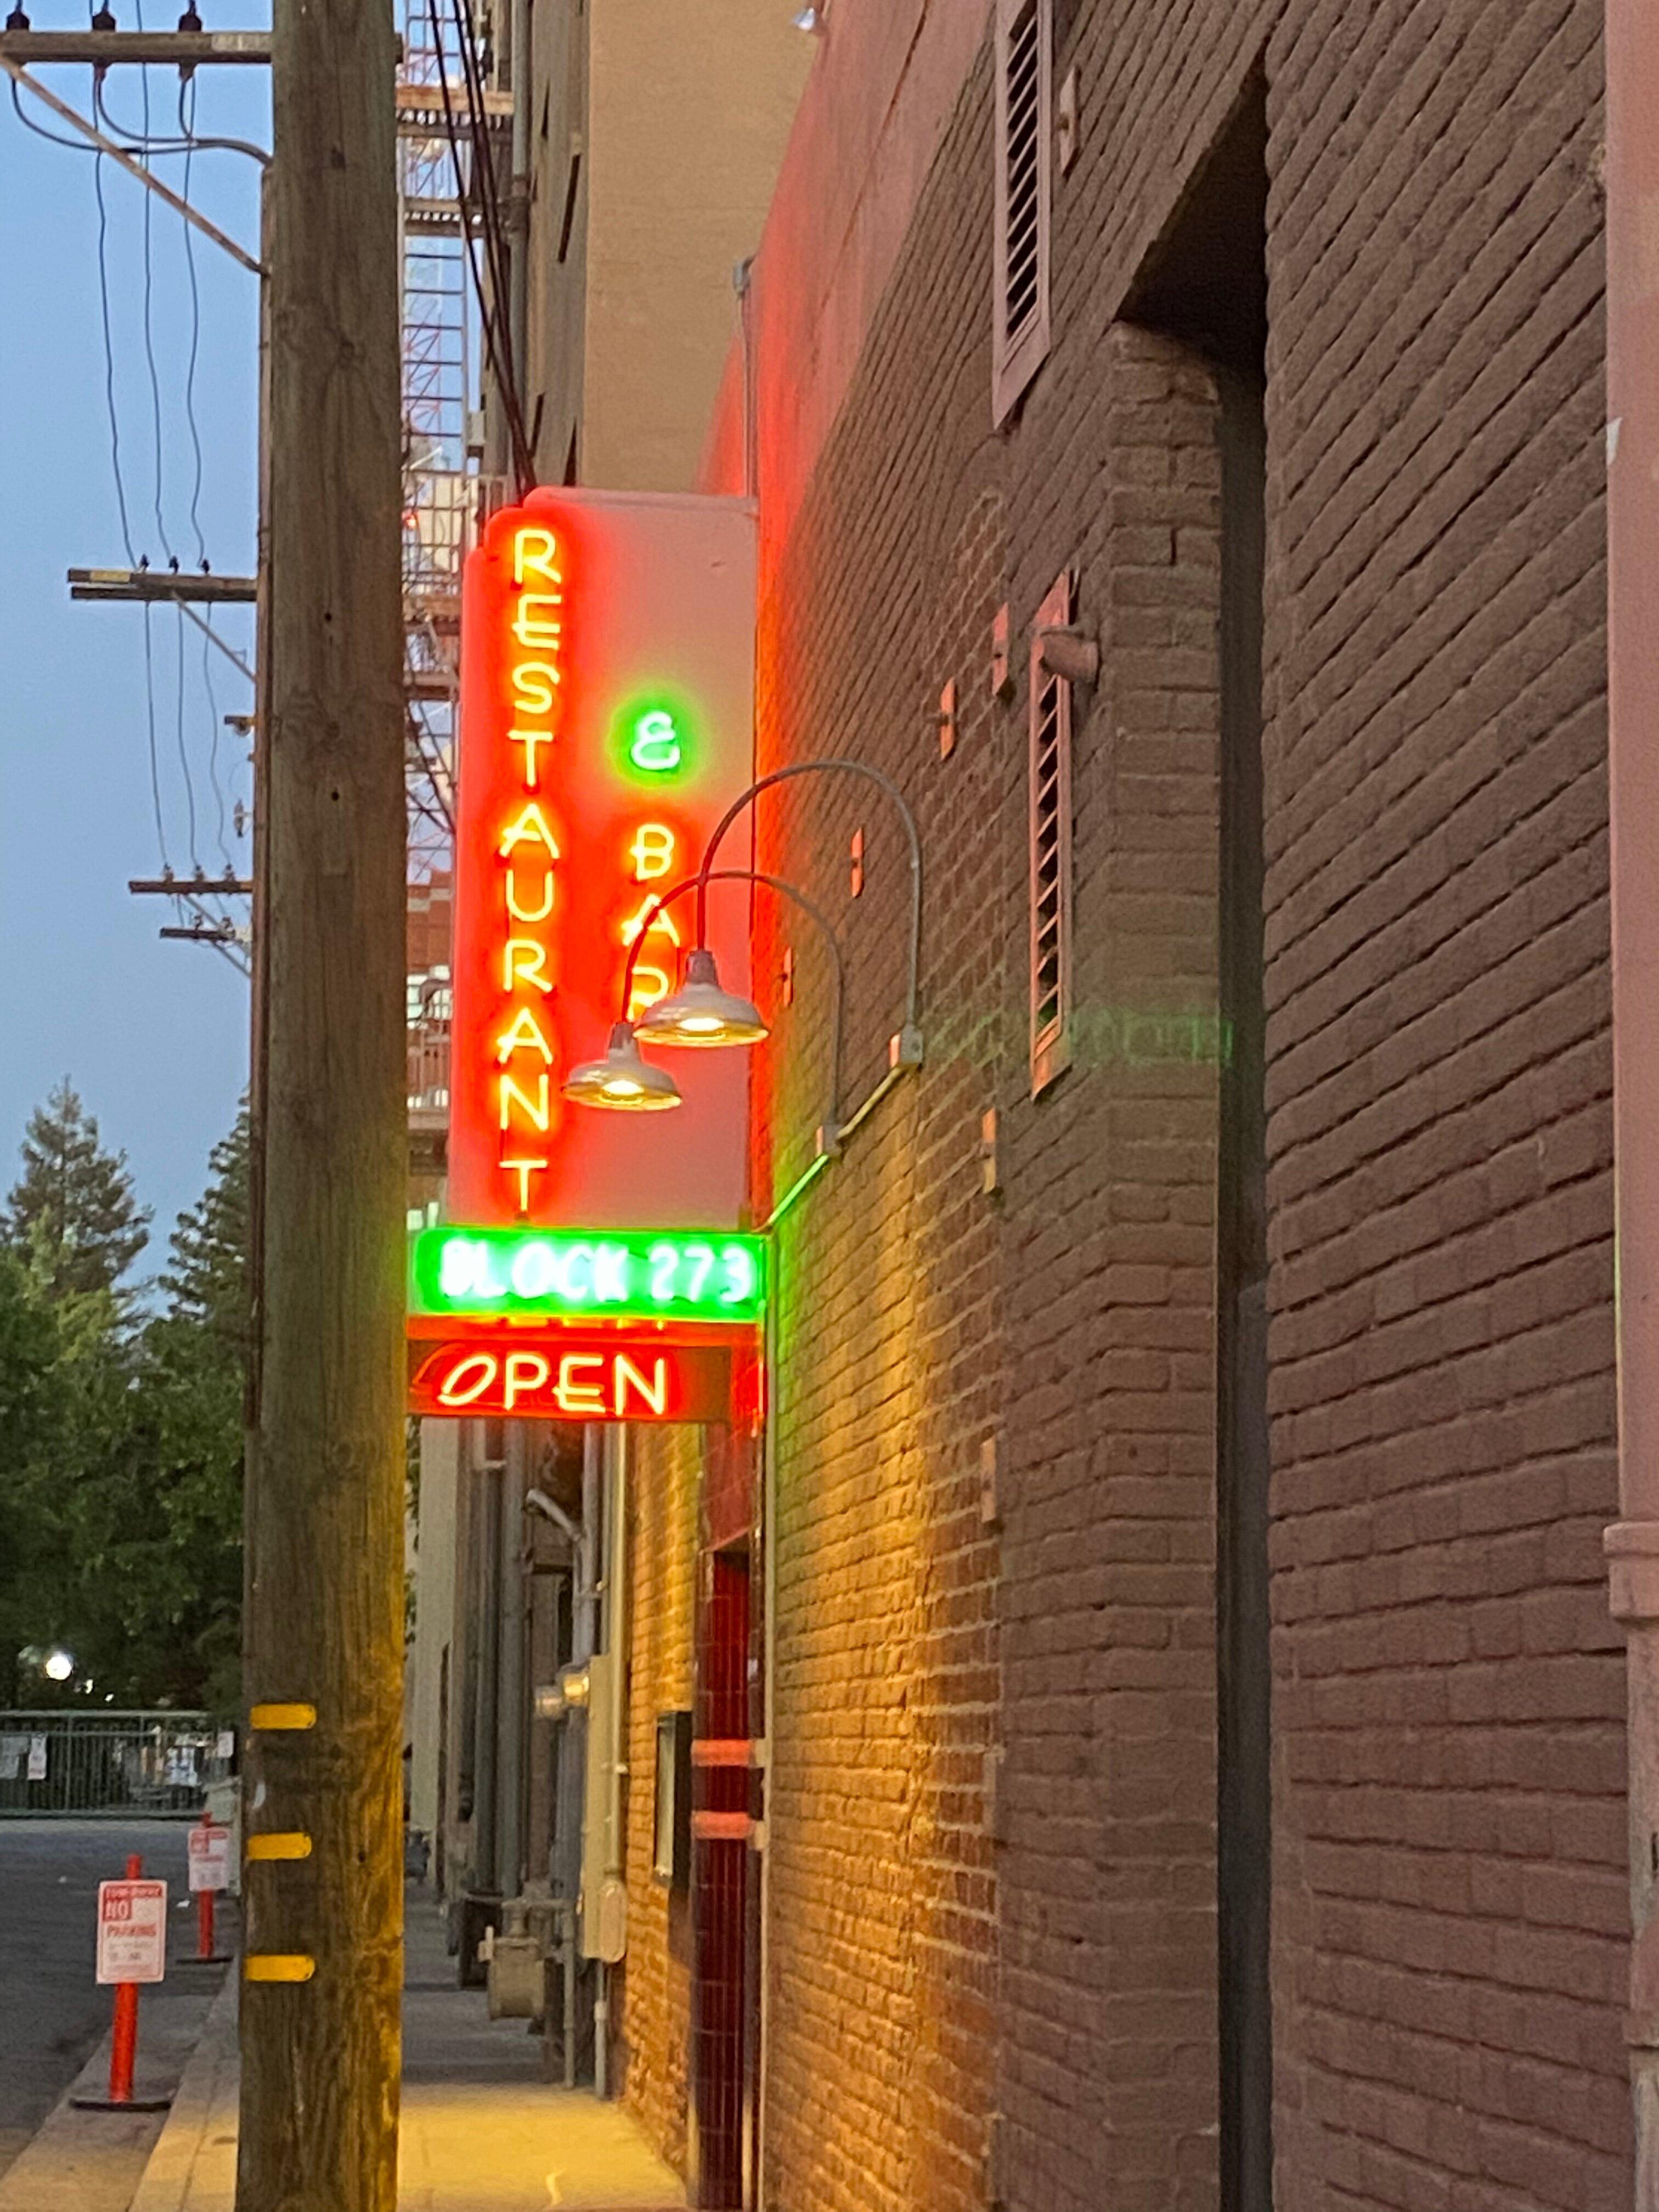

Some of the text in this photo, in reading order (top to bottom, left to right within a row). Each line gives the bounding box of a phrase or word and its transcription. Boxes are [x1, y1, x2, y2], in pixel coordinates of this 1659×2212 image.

[630, 711, 680, 770] &
[498, 528, 562, 1211] RESTAURANT
[440, 1239, 753, 1302] BLOCK 273
[438, 1353, 665, 1415] OPEN
